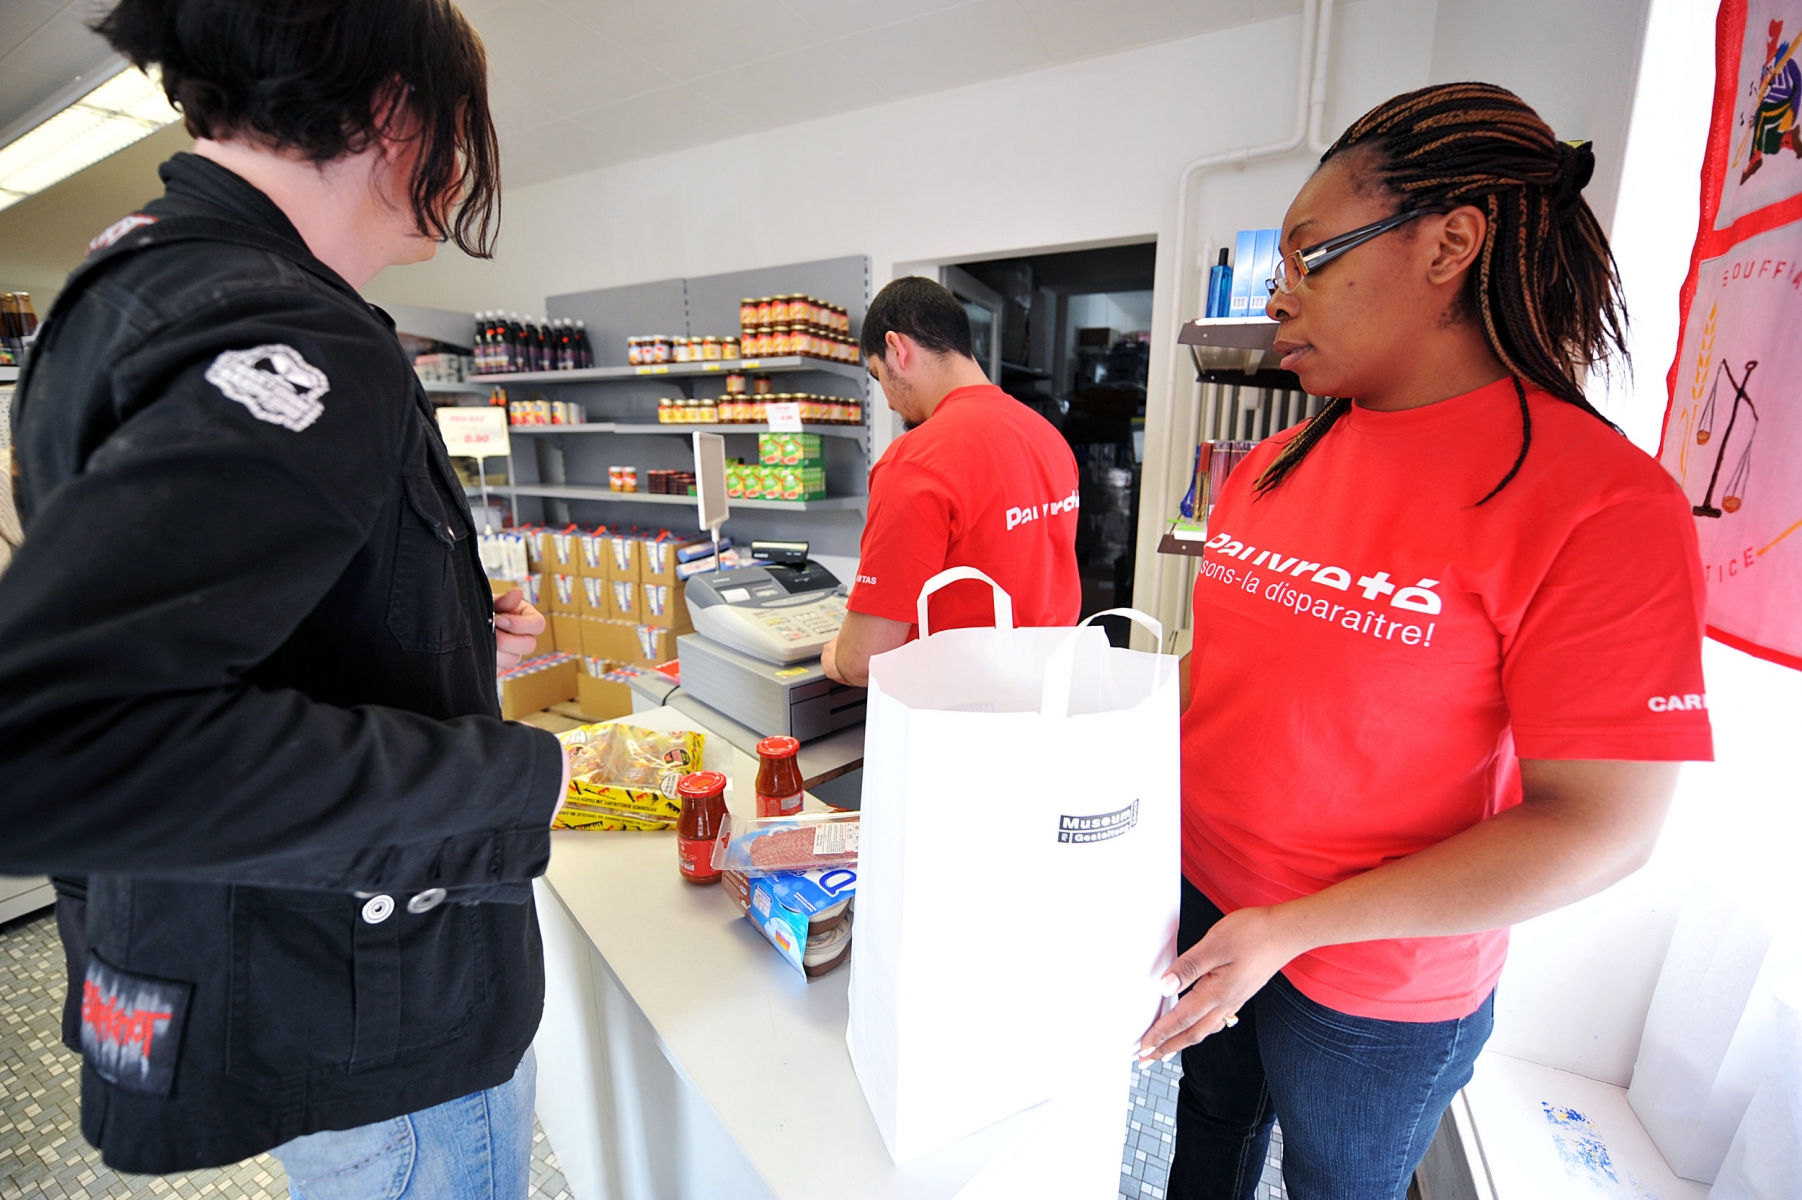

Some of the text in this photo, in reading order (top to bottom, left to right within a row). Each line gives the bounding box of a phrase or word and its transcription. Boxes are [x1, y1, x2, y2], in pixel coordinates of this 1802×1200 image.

[1705, 547, 1755, 583] TICE
[1200, 553, 1436, 648] sons-la disparaître!
[1062, 808, 1131, 830] Museum
